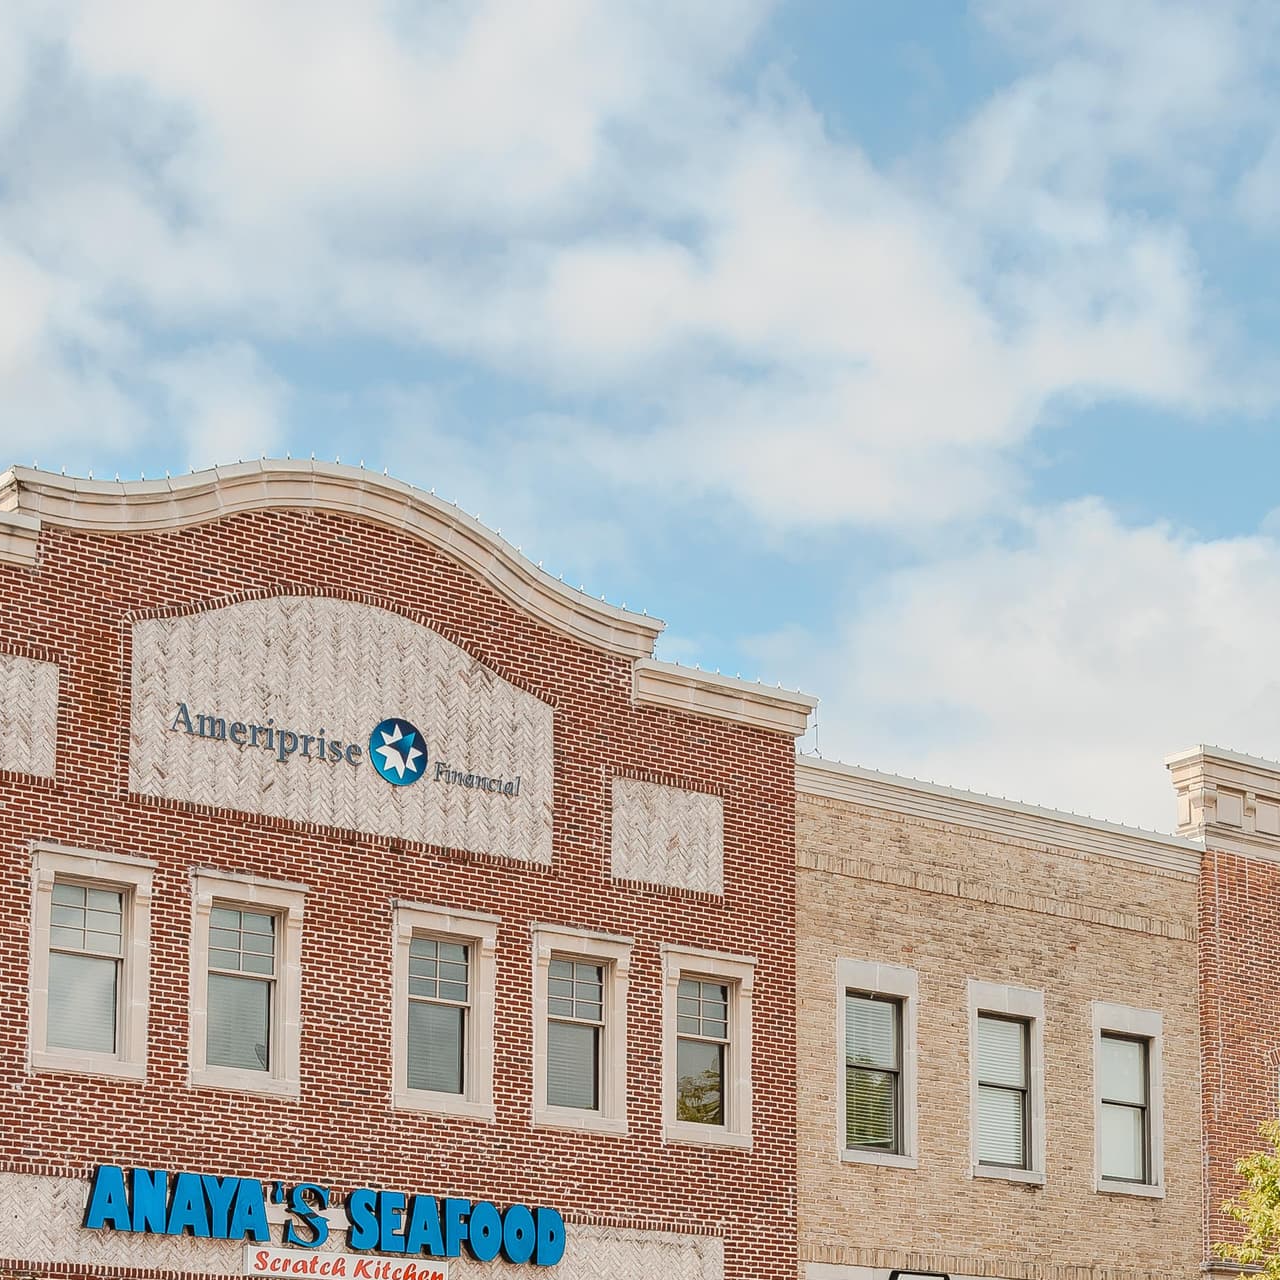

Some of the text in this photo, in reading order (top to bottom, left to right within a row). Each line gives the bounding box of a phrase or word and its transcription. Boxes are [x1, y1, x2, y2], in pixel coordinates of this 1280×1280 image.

[170, 702, 363, 766] Ameriprise
[434, 761, 521, 797] Financial
[85, 1165, 567, 1267] ANAYA'S SEAFOOD
[253, 1250, 347, 1277] Scratch
